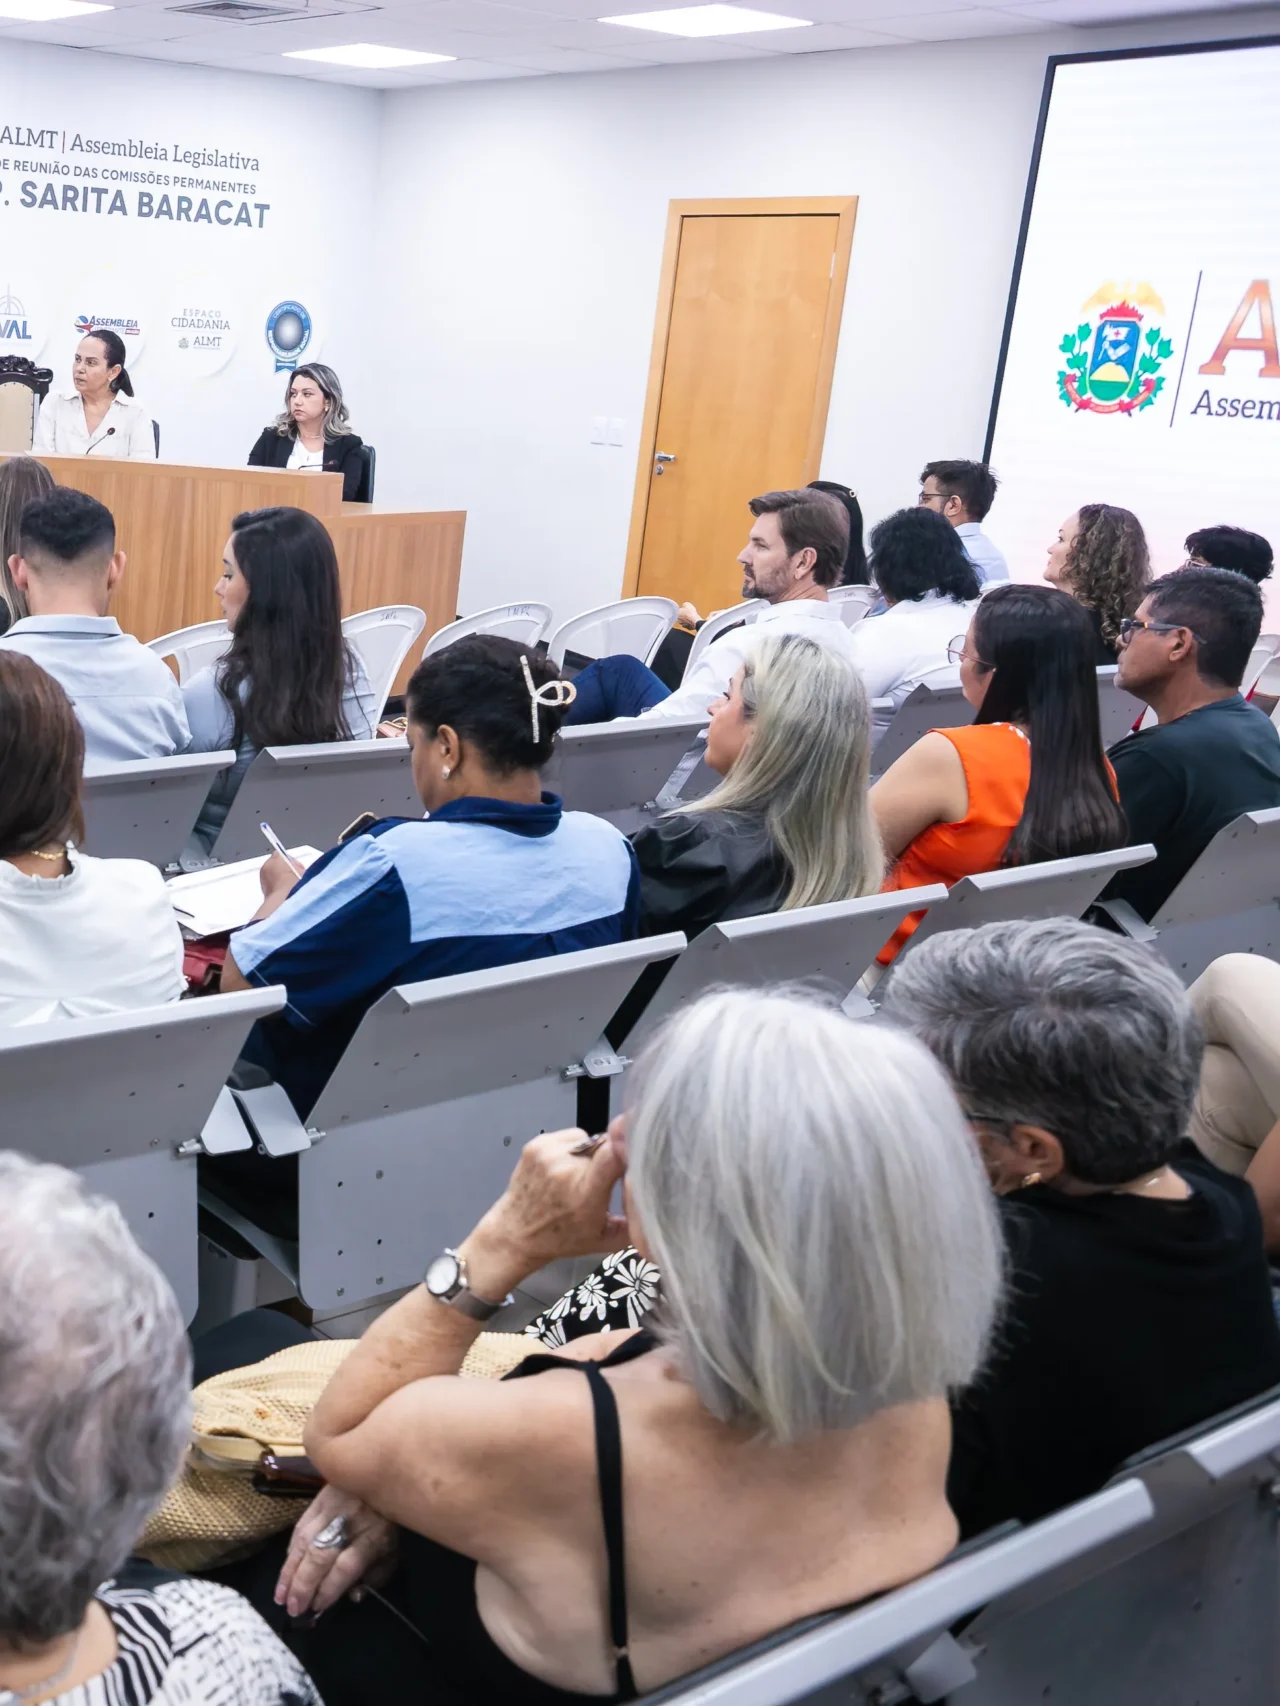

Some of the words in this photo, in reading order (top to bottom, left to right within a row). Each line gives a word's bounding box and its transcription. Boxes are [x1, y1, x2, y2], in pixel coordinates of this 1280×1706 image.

[70, 133, 168, 162] Assembleia
[173, 144, 260, 172] Legislativa
[13, 160, 70, 176] REUNIÃO
[73, 166, 98, 179] DAS
[101, 168, 170, 186] COMISSÕES
[173, 176, 257, 195] PERMANENTES
[19, 180, 128, 216] SARITA
[137, 191, 271, 229] BARACAT
[171, 317, 231, 330] CIDADANIA
[183, 308, 222, 319] ESPAÇO
[193, 336, 223, 347] ALMT
